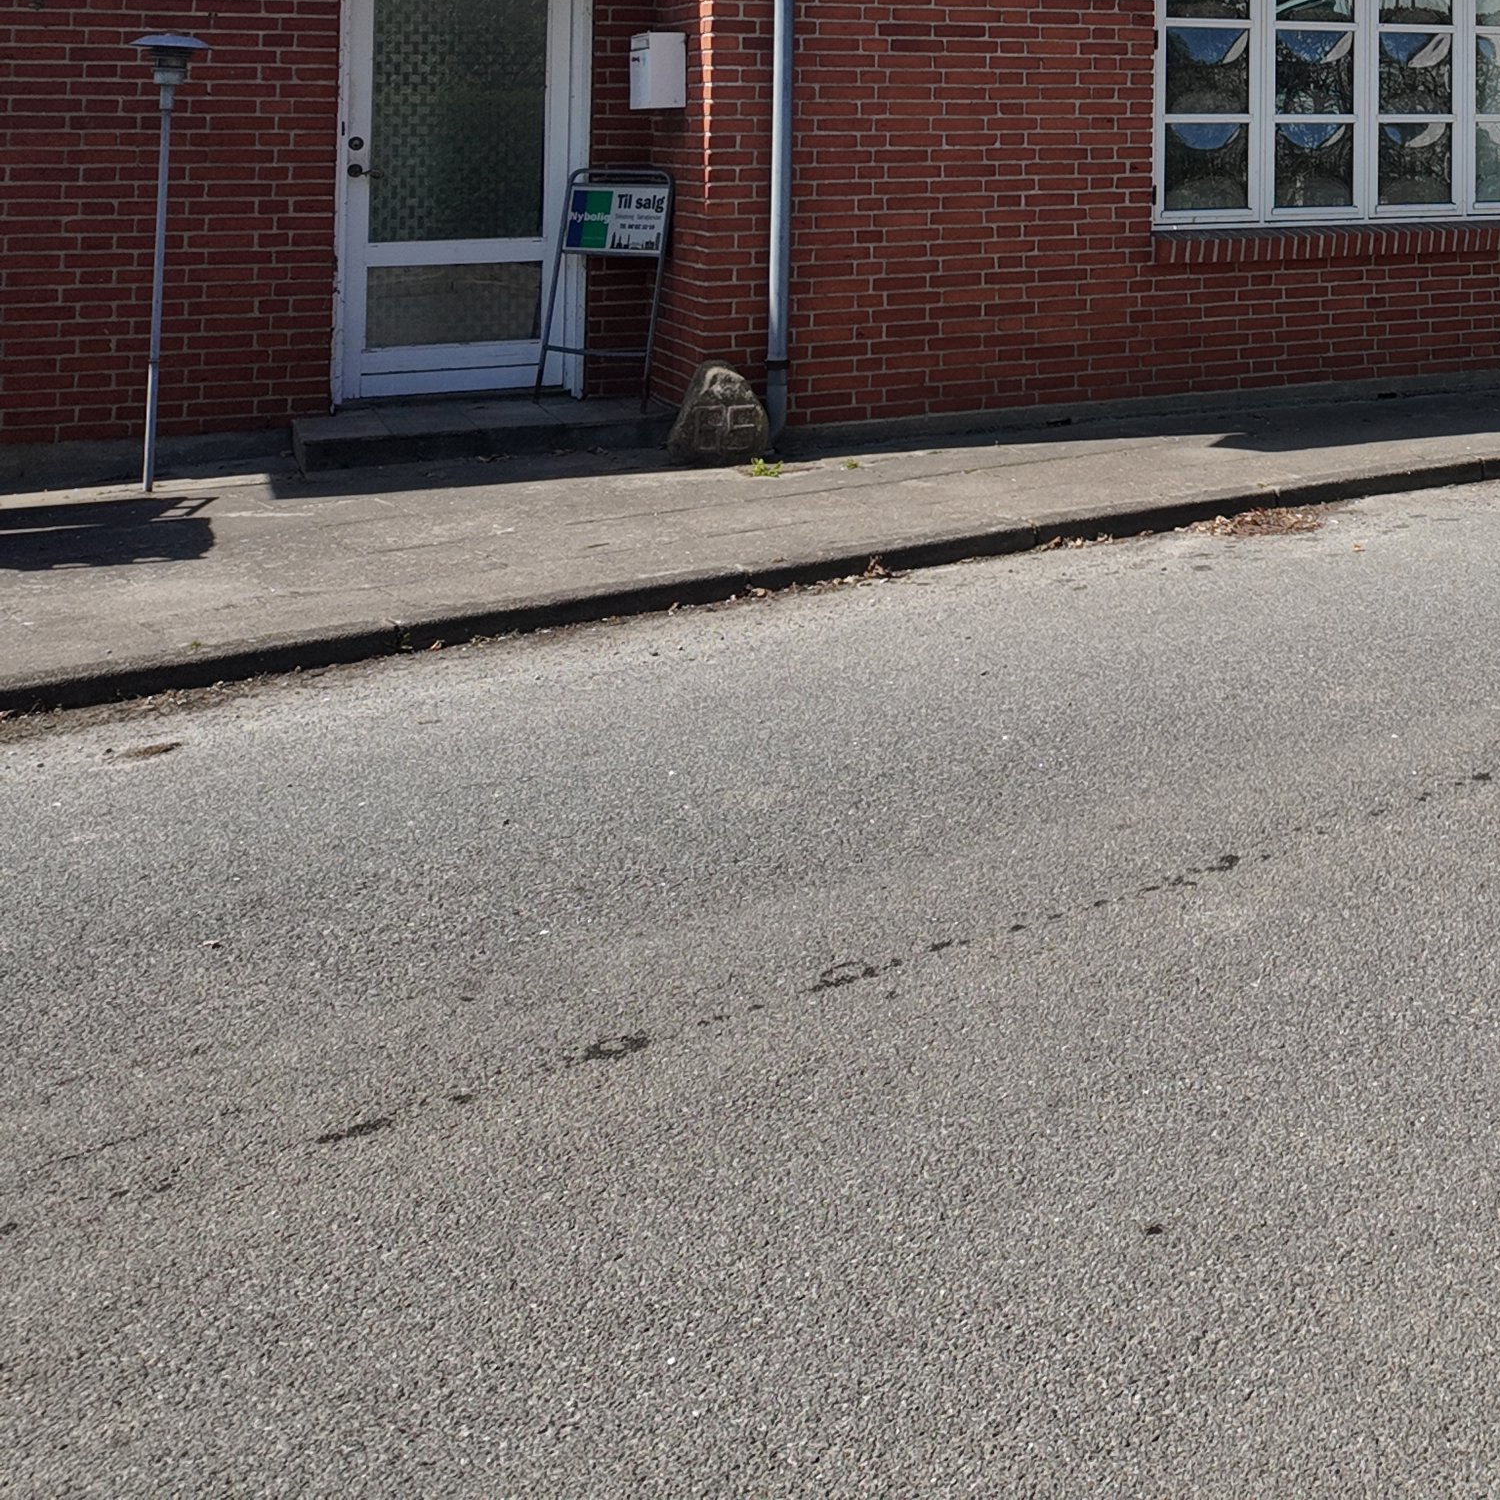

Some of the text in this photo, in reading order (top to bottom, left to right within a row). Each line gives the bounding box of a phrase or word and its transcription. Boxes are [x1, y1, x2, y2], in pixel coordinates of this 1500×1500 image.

[617, 193, 666, 214] Til salg
[568, 211, 610, 224] Nybolig
